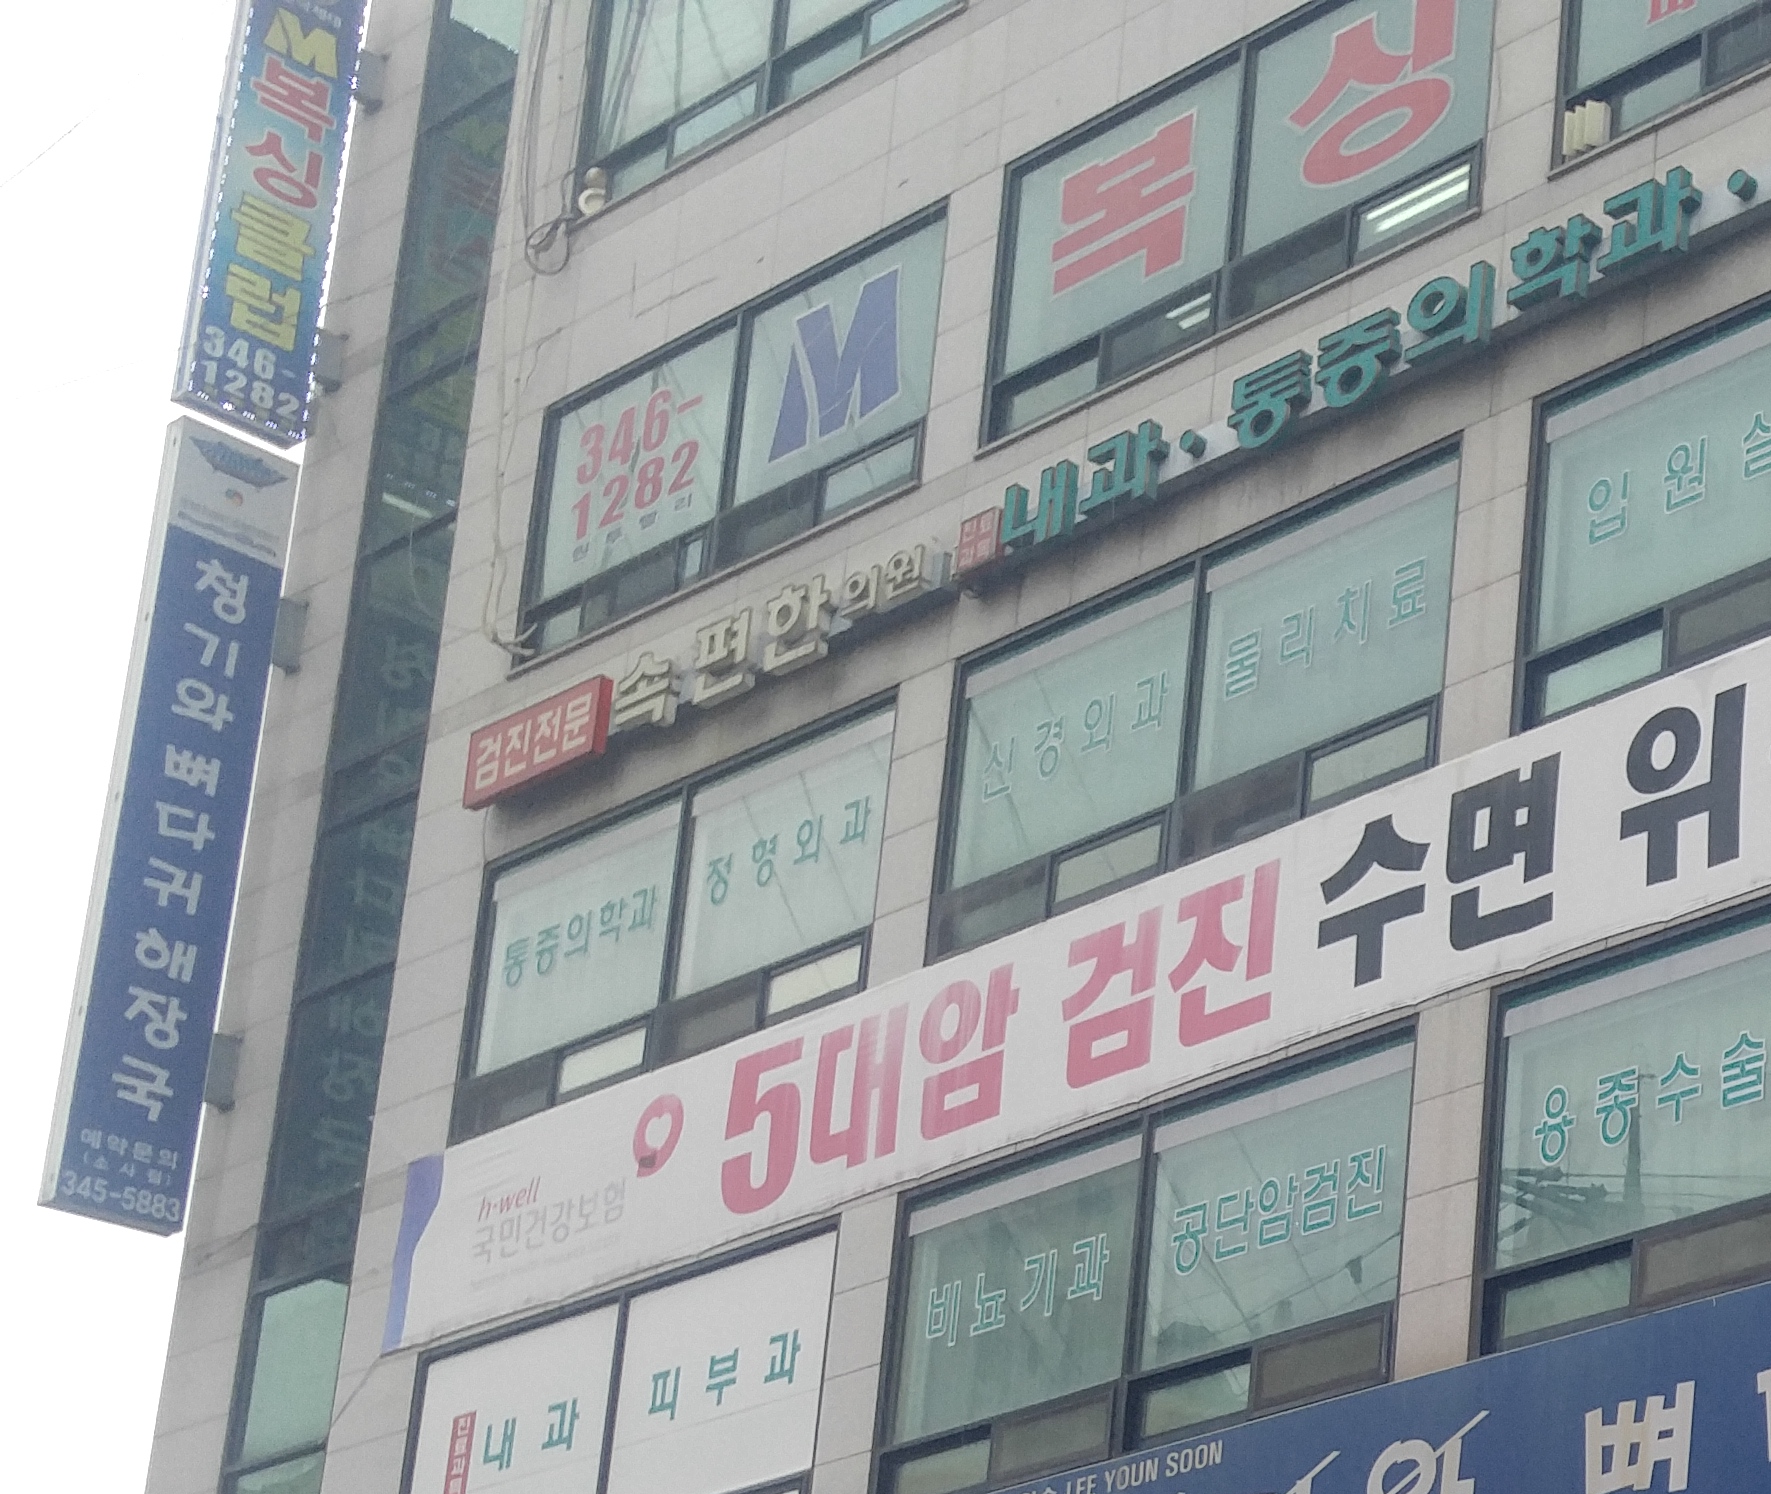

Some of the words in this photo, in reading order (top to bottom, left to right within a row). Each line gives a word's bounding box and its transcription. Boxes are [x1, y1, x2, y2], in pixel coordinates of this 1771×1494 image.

[263, 8, 338, 79] M
[223, 55, 336, 352] 복싱클럽
[200, 361, 299, 422] 1282
[769, 265, 902, 464] M
[572, 439, 699, 540] 1282
[577, 389, 703, 485] 346-
[172, 557, 249, 734] 청기와
[476, 691, 592, 791] 검진전문
[611, 573, 838, 728] 속편한
[842, 545, 926, 615] 의원
[1225, 556, 1428, 700] 물리치료
[982, 669, 1171, 802] 신경외과
[144, 745, 221, 915] 뼈다귀
[705, 795, 873, 906] 정형외과
[503, 886, 659, 988] 통증의학과
[720, 962, 1020, 1215] 5대암
[1061, 857, 1281, 1089] 검진
[1317, 751, 1562, 990] 수면
[111, 926, 196, 1122] 해장국
[1533, 1030, 1767, 1166] 용종수술
[60, 1170, 180, 1222] 345-5883
[472, 1178, 627, 1264] 국민건강보험
[1171, 1144, 1387, 1276] 공단암검진
[925, 1233, 1110, 1345] 비뇨기과
[648, 1328, 801, 1421] 피부과
[483, 1397, 580, 1471] 내과
[1105, 1457, 1158, 1493] YOUN
[1165, 1439, 1223, 1478] SOON
